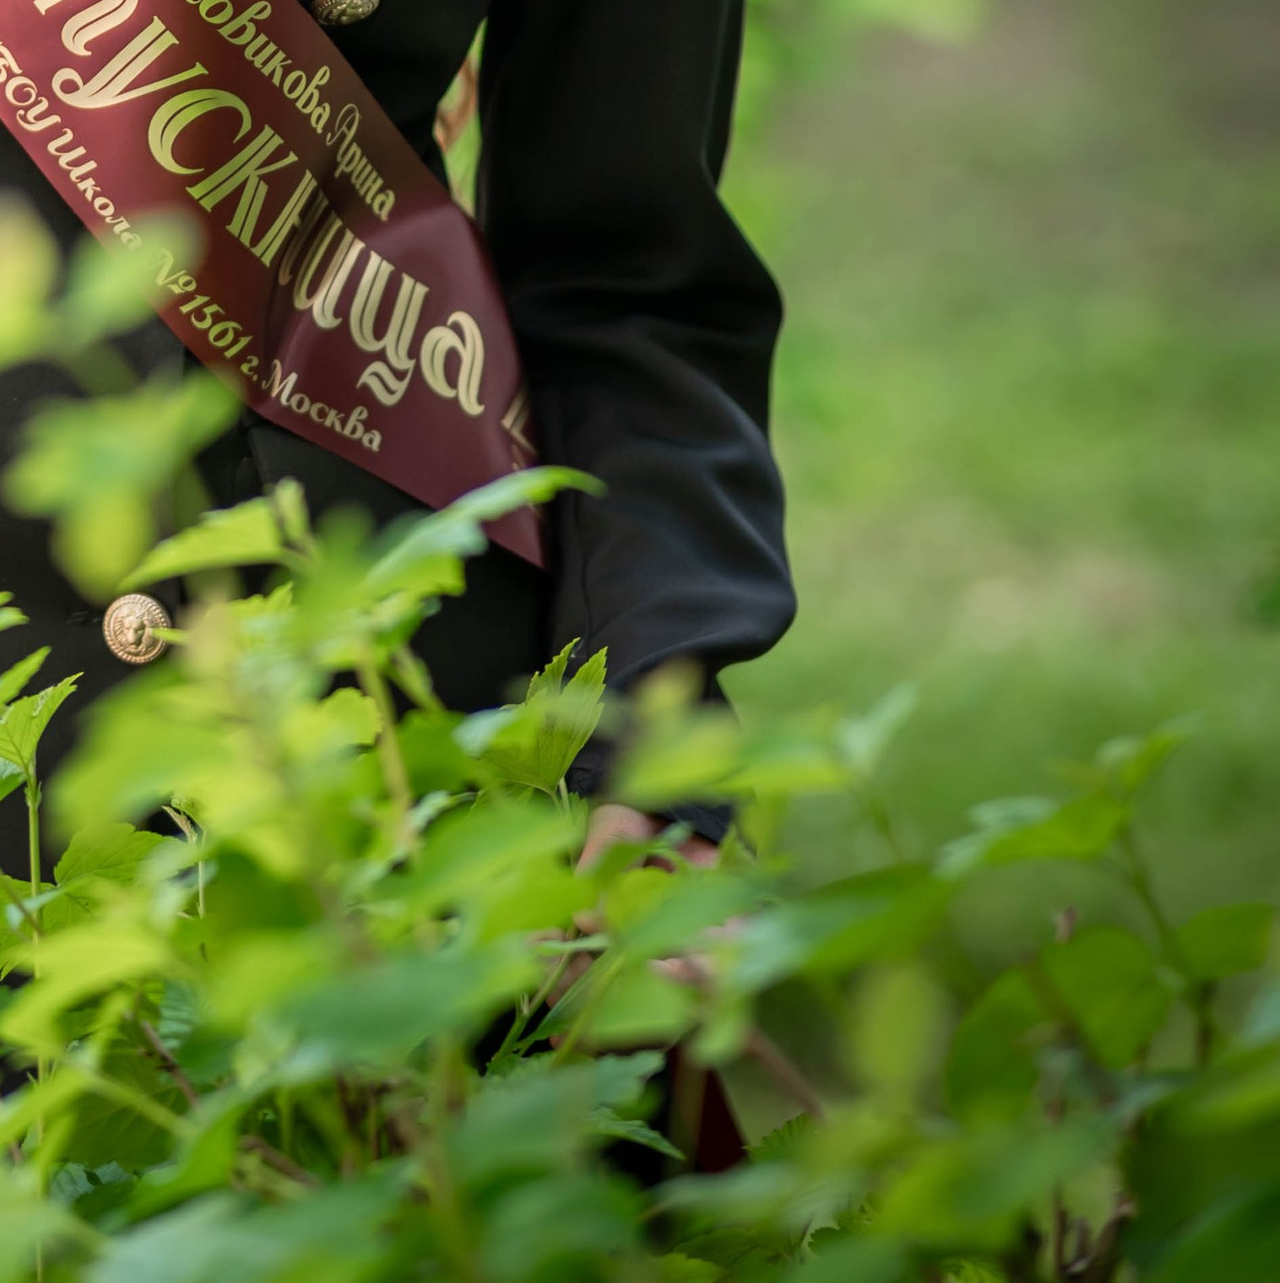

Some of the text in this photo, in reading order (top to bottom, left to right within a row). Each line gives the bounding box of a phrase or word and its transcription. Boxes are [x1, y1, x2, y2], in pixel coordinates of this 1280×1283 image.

[326, 103, 397, 222] Арина
[46, 127, 143, 251] Школа
[261, 358, 384, 453] Москва
